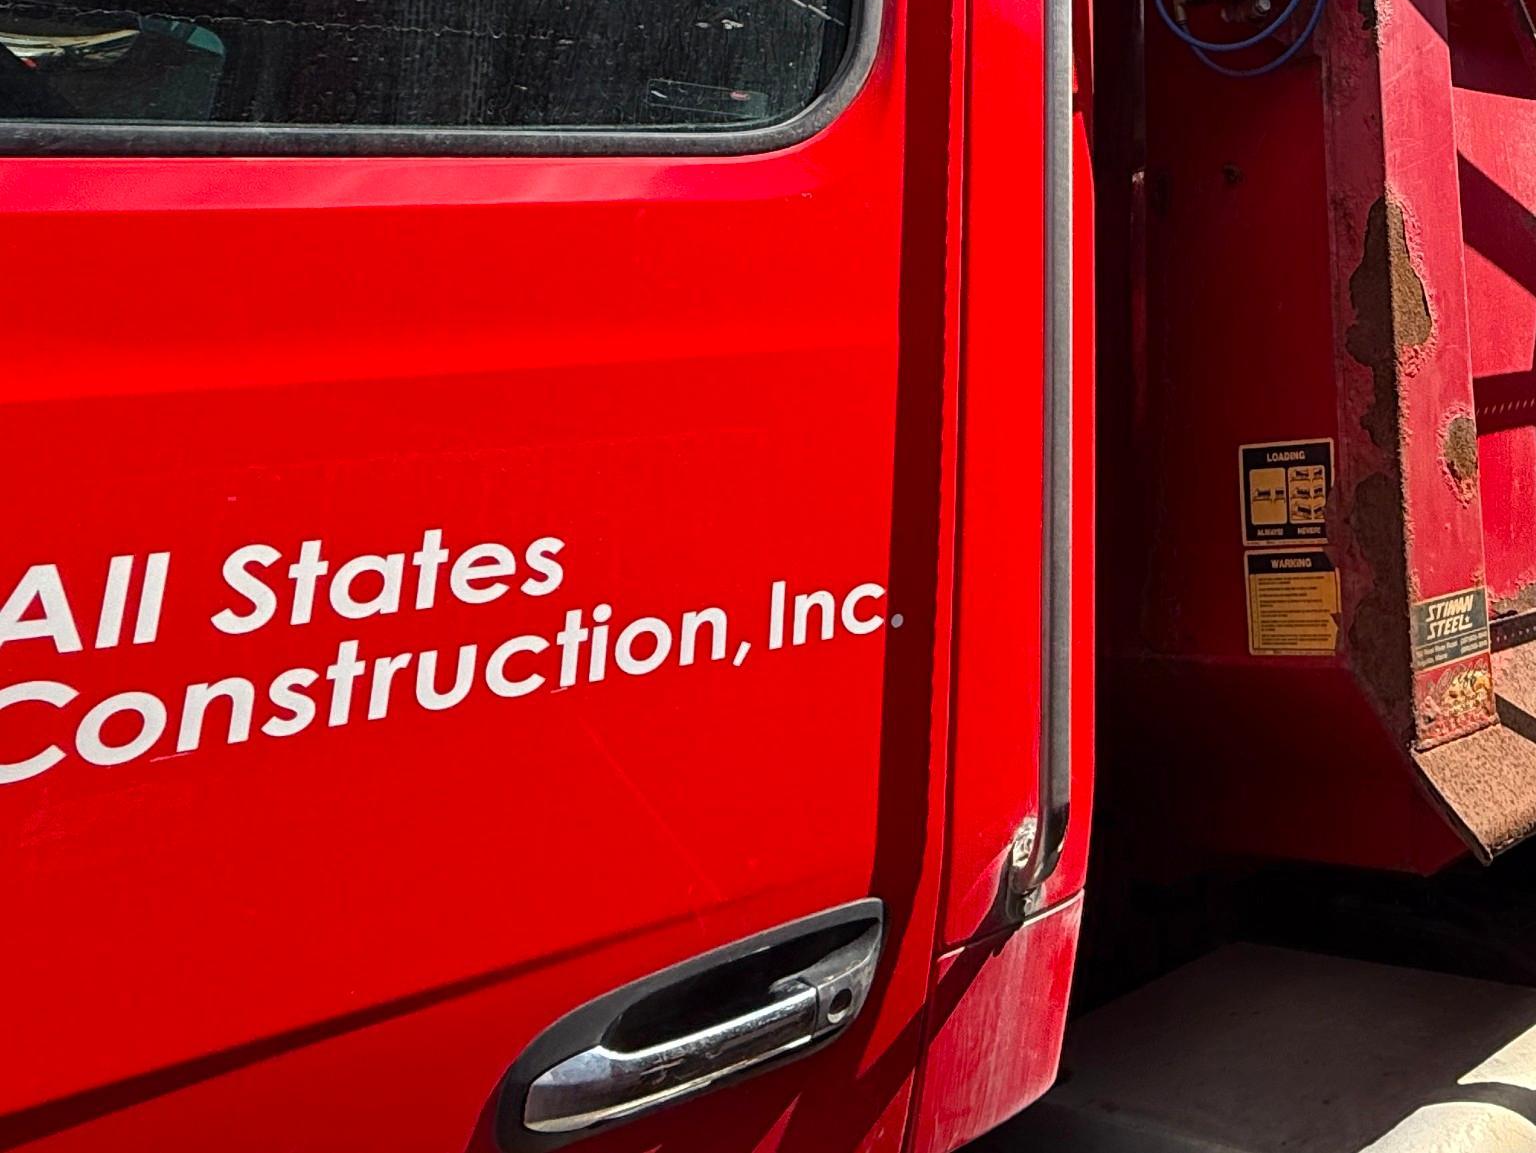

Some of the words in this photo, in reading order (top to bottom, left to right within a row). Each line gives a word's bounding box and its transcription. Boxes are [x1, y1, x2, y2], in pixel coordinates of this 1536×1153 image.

[1266, 450, 1306, 463] LOADING
[1270, 557, 1313, 569] WARNING
[0, 552, 171, 654] All
[211, 529, 566, 635] States
[1426, 614, 1474, 641] STEEL
[0, 604, 752, 785] Construction,
[768, 581, 904, 650] Inc.
